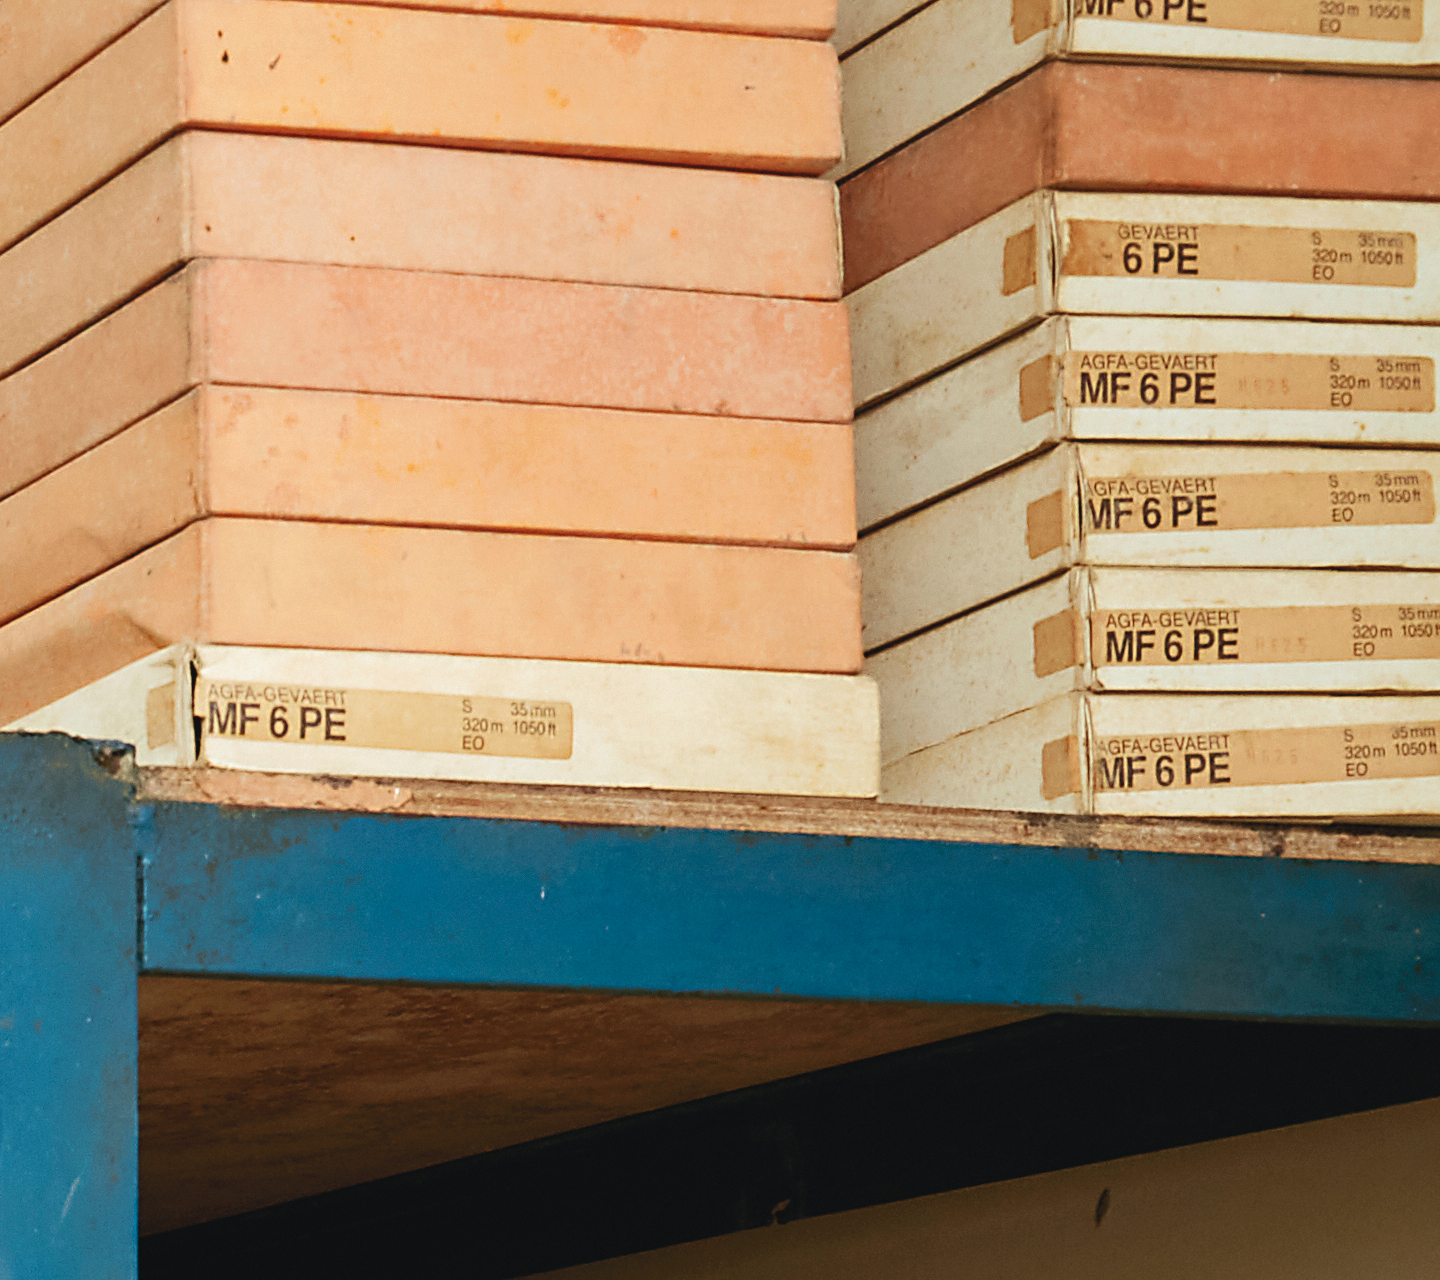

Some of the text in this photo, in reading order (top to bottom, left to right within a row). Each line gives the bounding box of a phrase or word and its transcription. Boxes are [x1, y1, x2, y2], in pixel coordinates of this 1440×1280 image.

[1162, 0, 1208, 23] PE
[1118, 225, 1199, 241] GEVAERT
[1123, 243, 1199, 275] 6 PE
[1312, 266, 1334, 281] EO
[1081, 354, 1218, 370] AGFA-GEVAERT
[1080, 373, 1132, 405] MF
[1140, 373, 1159, 405] 6
[1170, 373, 1216, 405] PE
[1331, 393, 1352, 407] EO
[1087, 495, 1218, 530] MF 6 PE
[1332, 507, 1354, 523] EO
[1106, 610, 1240, 628] AGFA-GEVAERT
[1106, 630, 1155, 663] MF
[1164, 630, 1183, 662] 6
[1194, 628, 1239, 661] PE
[1353, 642, 1375, 657] EO
[208, 684, 347, 706] AGFA-GEVAERT
[208, 701, 347, 742] MF 6 PE
[462, 736, 485, 751] EO
[1099, 756, 1146, 790] MF
[1155, 755, 1175, 787] 6
[1185, 753, 1231, 786] PE
[1346, 763, 1368, 777] EO
